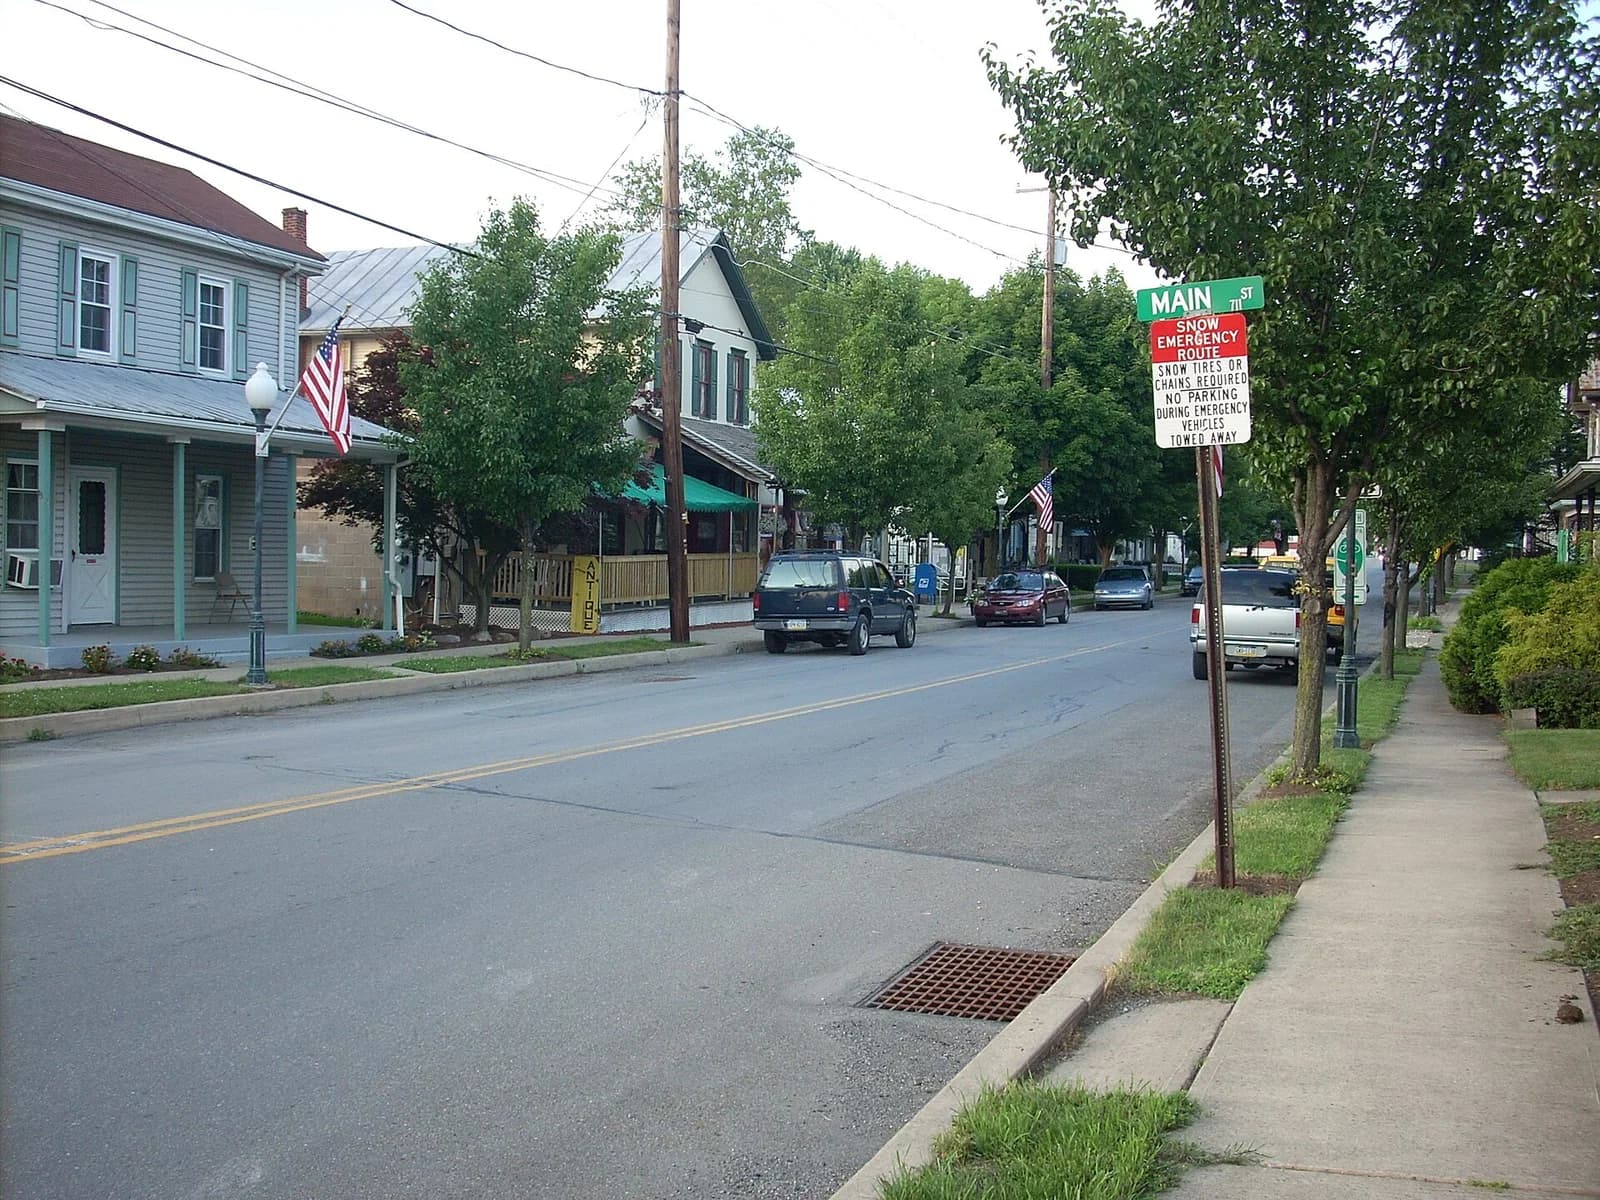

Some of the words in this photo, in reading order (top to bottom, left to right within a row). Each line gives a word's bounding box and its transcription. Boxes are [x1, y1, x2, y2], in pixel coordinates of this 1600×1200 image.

[1152, 286, 1211, 315] MAIN
[1241, 287, 1253, 299] ST
[1177, 319, 1219, 332] SNOW
[1158, 330, 1238, 348] EMERGENCY
[1178, 347, 1220, 360] ROUTE
[1159, 364, 1187, 376] SNOW
[1193, 361, 1222, 374] TIRES
[1229, 360, 1242, 370] OR
[1156, 377, 1190, 391] CHAINS
[1198, 373, 1246, 388] REQUIRED
[1166, 393, 1181, 404] NO
[1189, 388, 1237, 402] PARKING
[1157, 407, 1189, 419] DURING
[1195, 402, 1248, 417] EMERGENCY
[1182, 418, 1224, 431] VEHICLES
[1171, 434, 1204, 446] TOWED
[1211, 432, 1237, 443] AWAY
[584, 561, 595, 629] ANTIQUE
